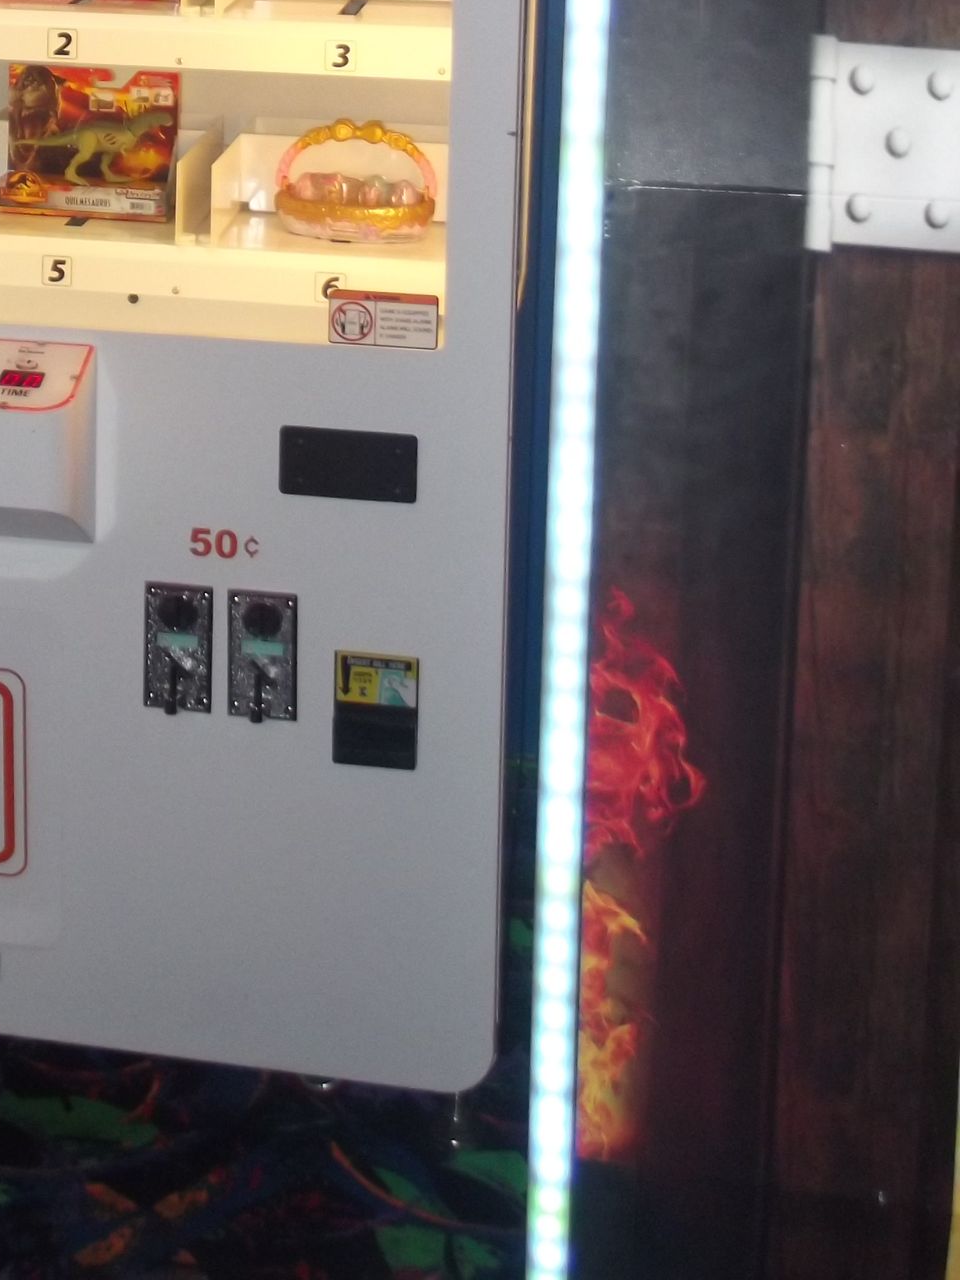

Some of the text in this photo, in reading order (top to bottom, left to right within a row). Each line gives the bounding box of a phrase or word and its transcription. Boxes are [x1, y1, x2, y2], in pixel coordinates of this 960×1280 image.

[53, 32, 73, 56] 2
[331, 43, 351, 68] 3
[48, 259, 67, 283] 5
[1, 388, 31, 397] TIME
